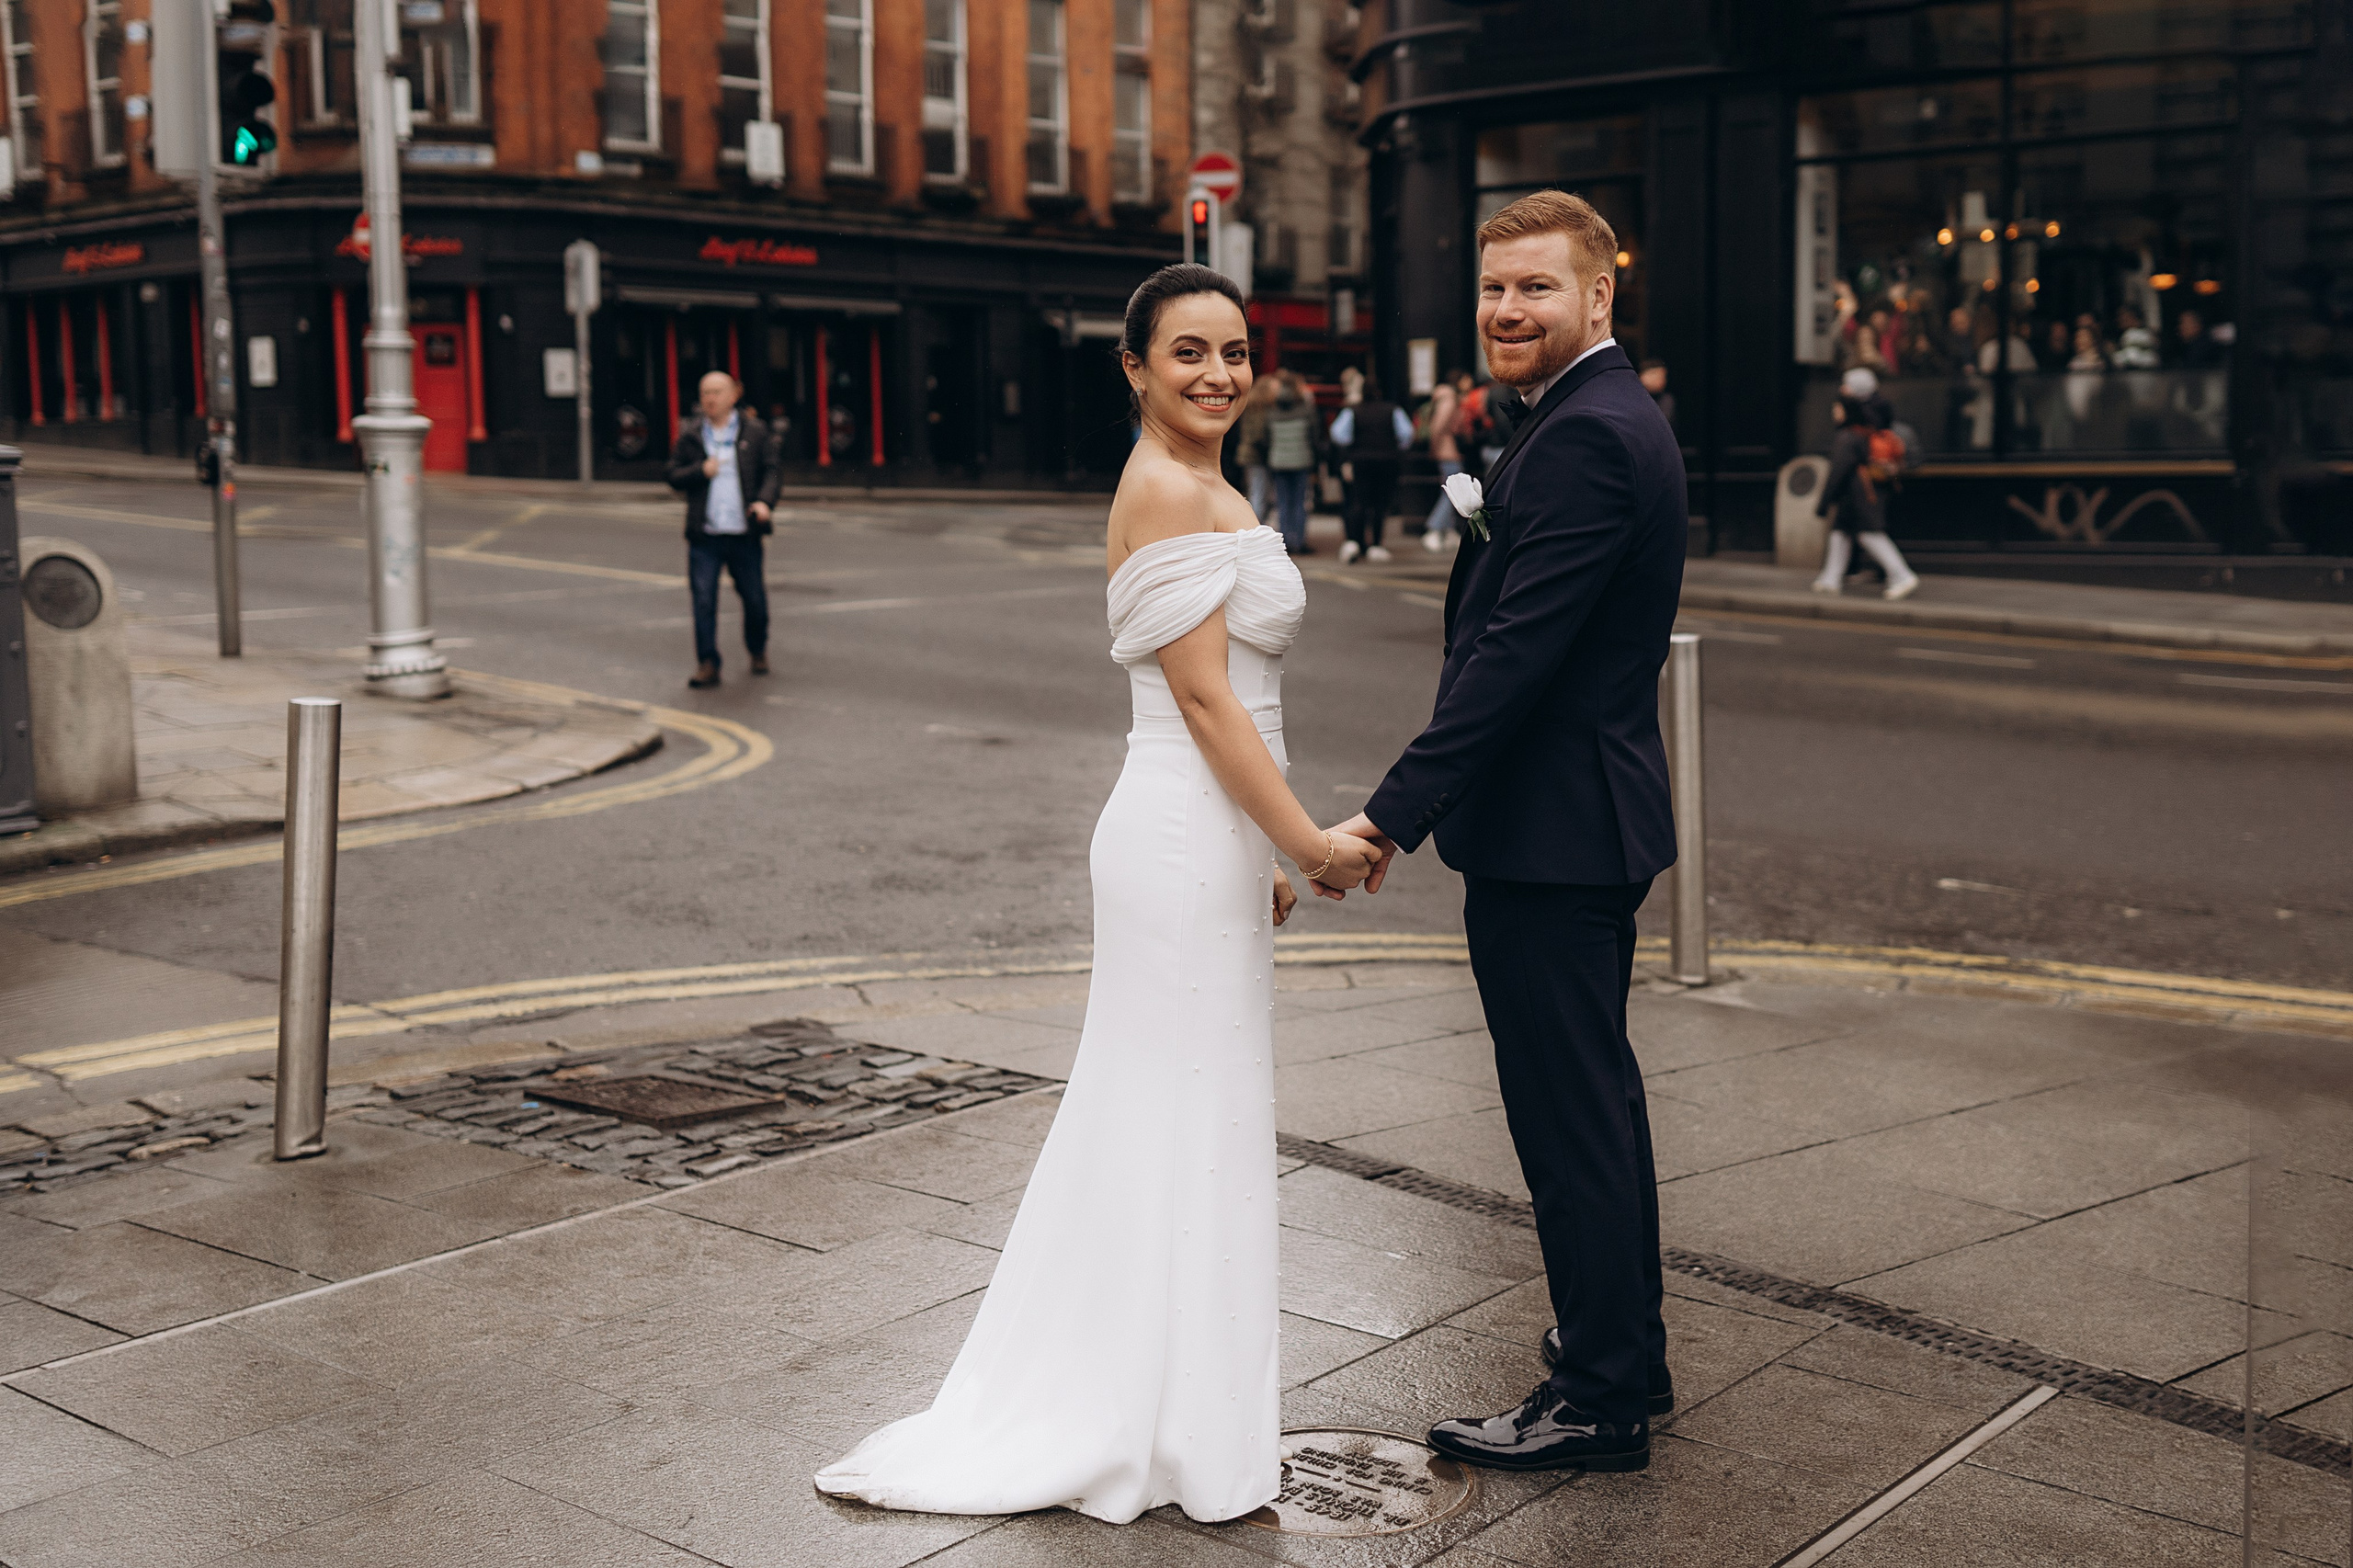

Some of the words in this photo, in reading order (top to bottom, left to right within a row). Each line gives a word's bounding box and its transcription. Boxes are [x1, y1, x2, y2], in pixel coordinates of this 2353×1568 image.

[1346, 1469, 1374, 1480] FOR
[1300, 1482, 1344, 1497] BORN
[1304, 1493, 1377, 1517] THOMAS
